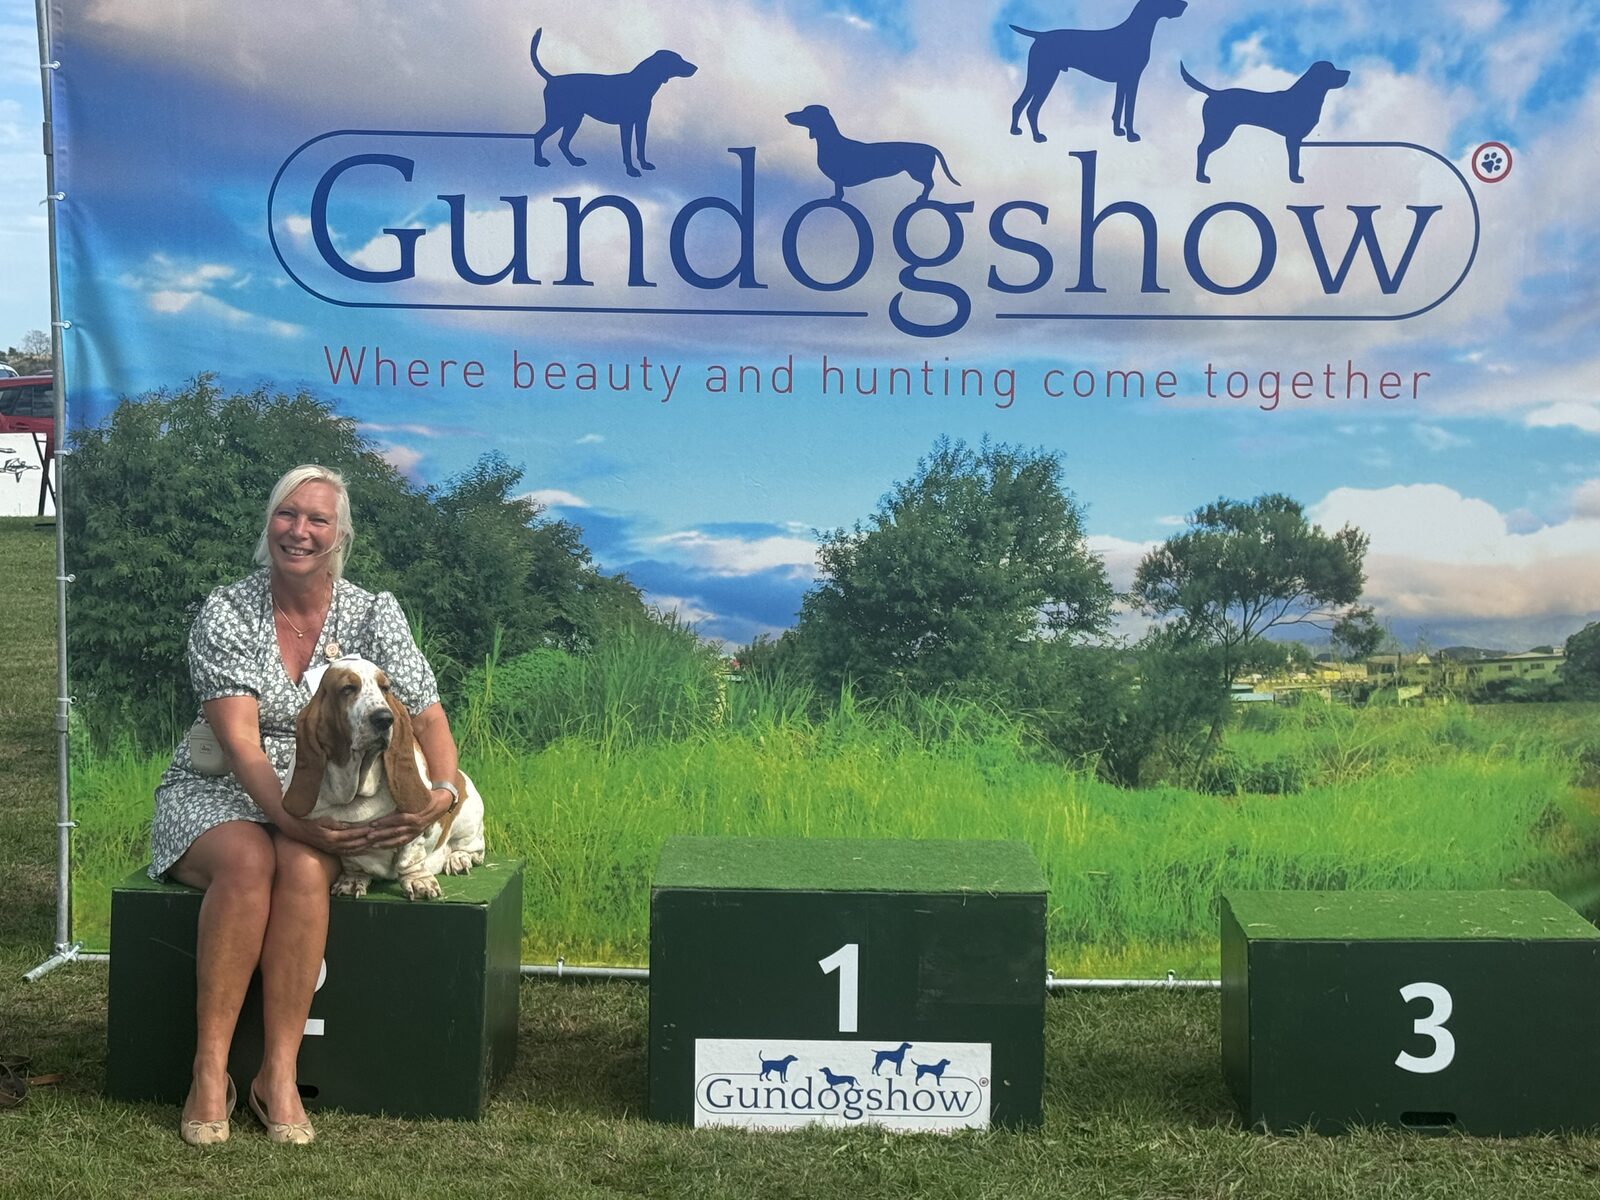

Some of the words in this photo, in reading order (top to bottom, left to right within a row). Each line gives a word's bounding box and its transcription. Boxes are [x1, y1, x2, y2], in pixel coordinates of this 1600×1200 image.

[310, 147, 1443, 338] Gundogshow
[323, 346, 486, 389] Where
[513, 350, 682, 403] beauty
[705, 355, 794, 395] and
[822, 355, 1017, 409] hunting
[1043, 370, 1179, 399] come
[1204, 359, 1432, 412] together
[818, 943, 859, 1033] 1
[1394, 981, 1456, 1074] 3
[705, 1076, 974, 1121] Gundogshow
